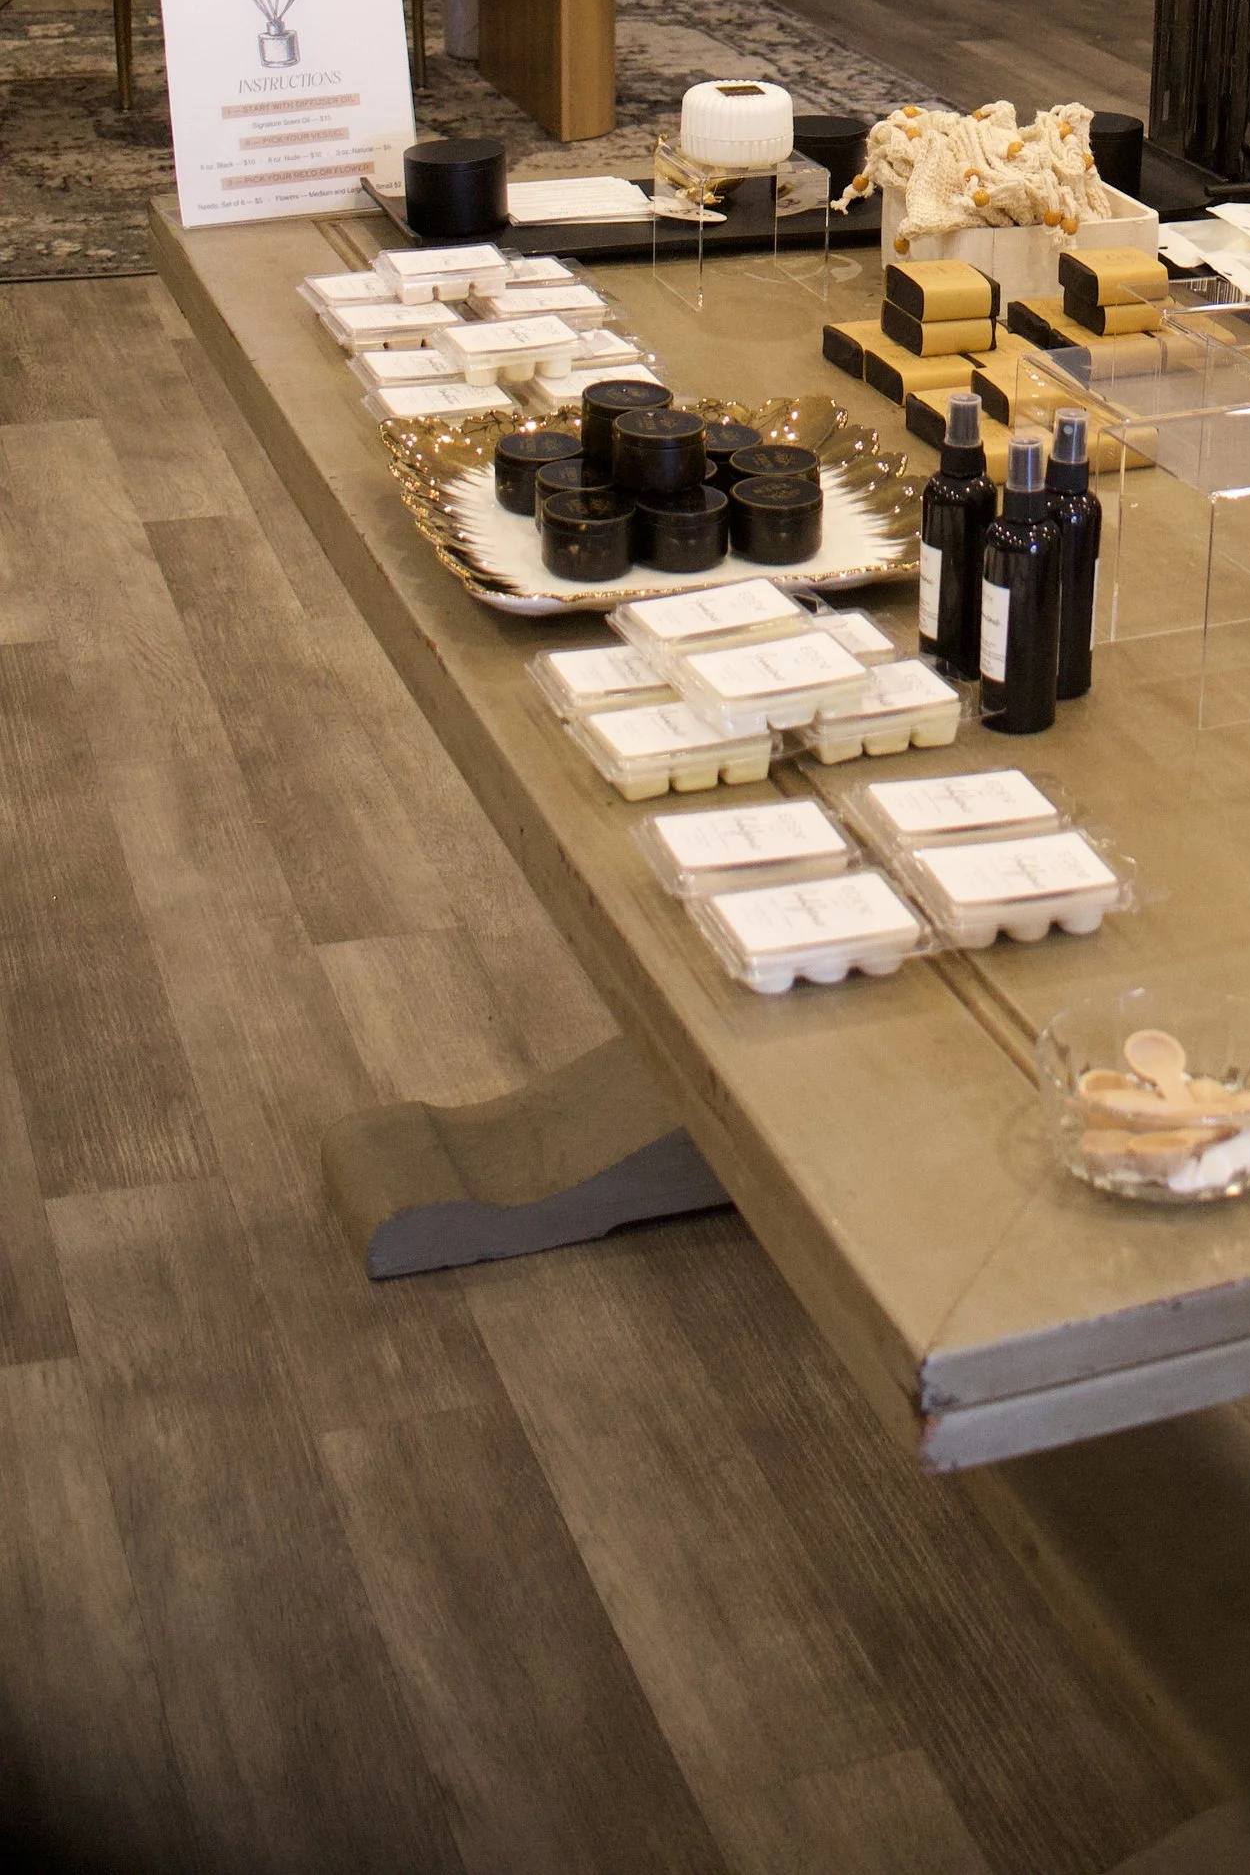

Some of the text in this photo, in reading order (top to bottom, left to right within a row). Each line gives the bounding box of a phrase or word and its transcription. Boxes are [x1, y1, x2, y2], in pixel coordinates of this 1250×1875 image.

[238, 71, 342, 94] INSTRUCTIONS
[243, 103, 270, 114] START
[272, 101, 294, 110] WITH
[296, 97, 338, 108] DIFFUSER
[341, 94, 357, 103] OIL
[252, 120, 282, 130] Signature
[283, 118, 301, 126] Scent
[302, 116, 311, 124] Oil
[263, 135, 283, 144] PICK
[285, 133, 309, 142] YOUR
[311, 130, 344, 140] VESSEL
[216, 160, 234, 170] Black
[352, 145, 374, 154] Natural
[245, 175, 265, 185] PICK
[267, 172, 293, 182] YOUR
[319, 167, 333, 176] OR
[335, 164, 370, 174] FLOWER
[275, 193, 299, 203] Flowers
[309, 190, 333, 199] Medium
[334, 188, 345, 196] and
